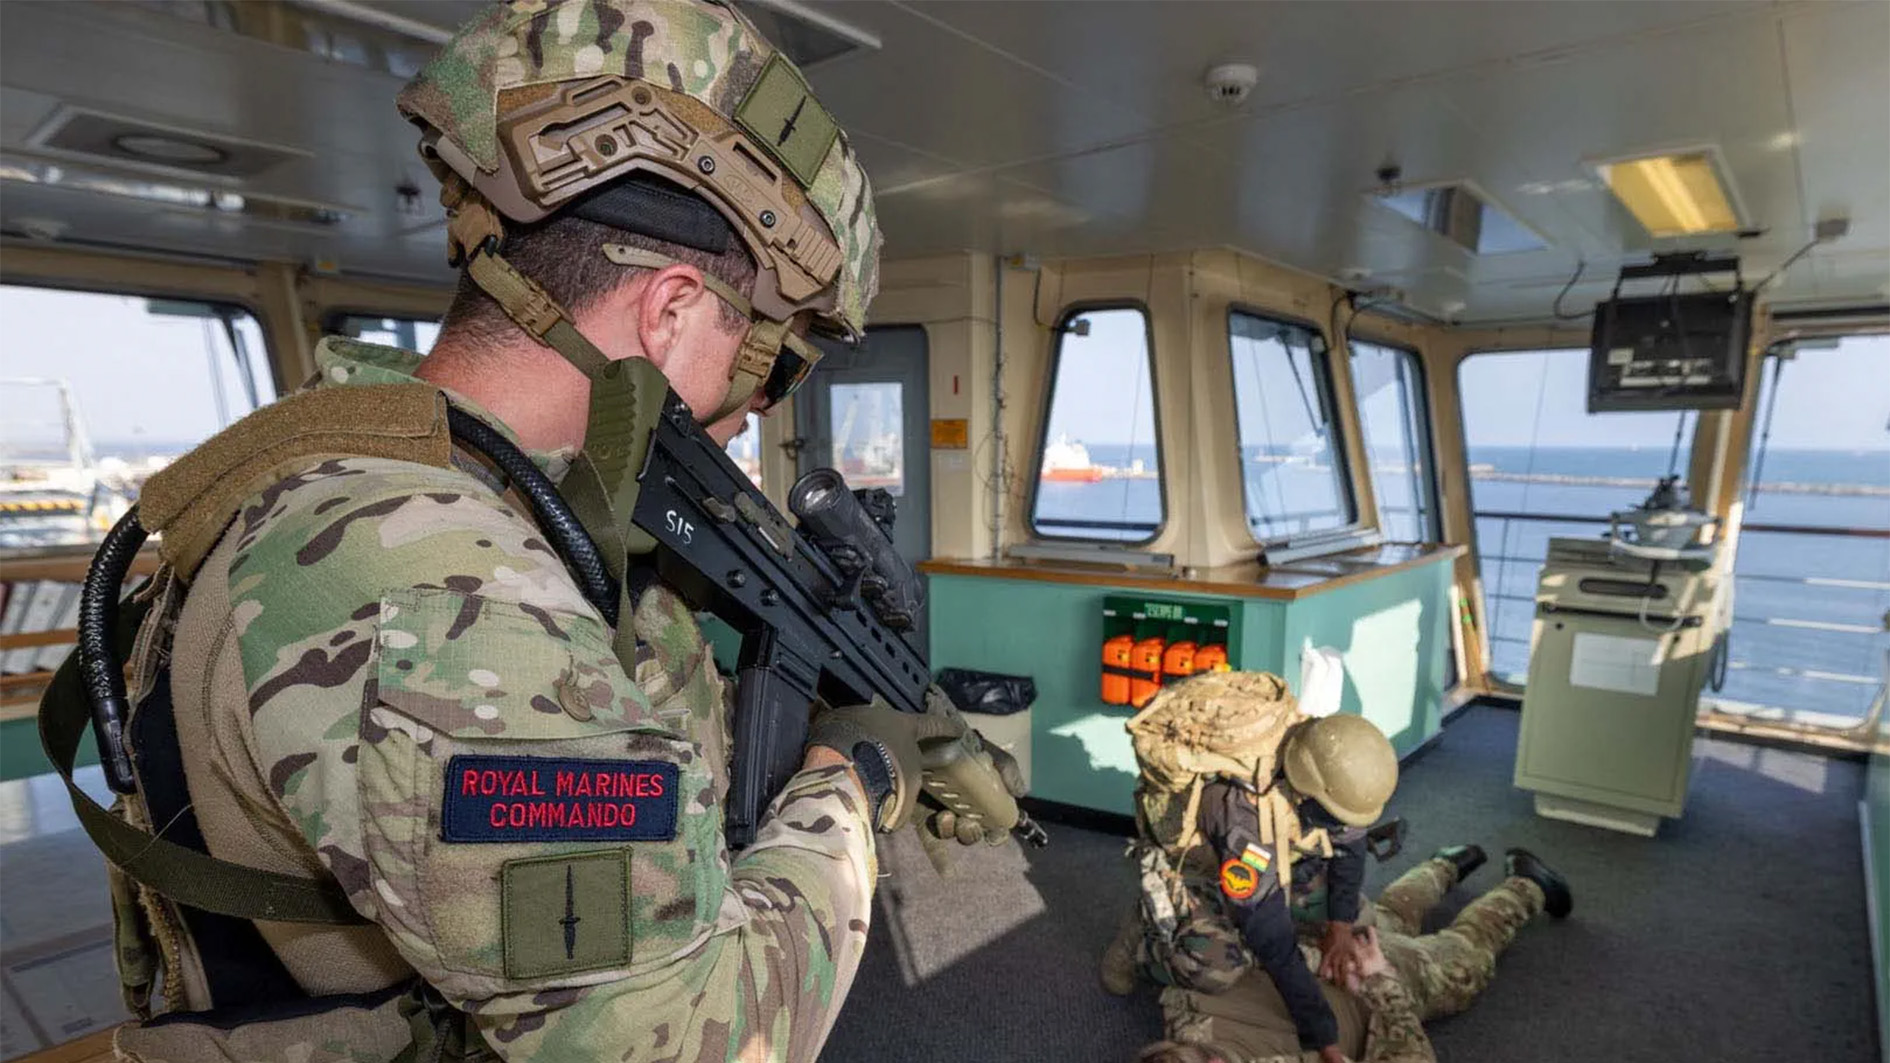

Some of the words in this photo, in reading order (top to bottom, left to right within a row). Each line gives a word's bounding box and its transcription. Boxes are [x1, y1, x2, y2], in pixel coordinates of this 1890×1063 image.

[665, 510, 694, 544] S15
[461, 769, 545, 796] ROYAL
[556, 771, 664, 797] MARINES
[490, 803, 636, 828] COMMANDO
